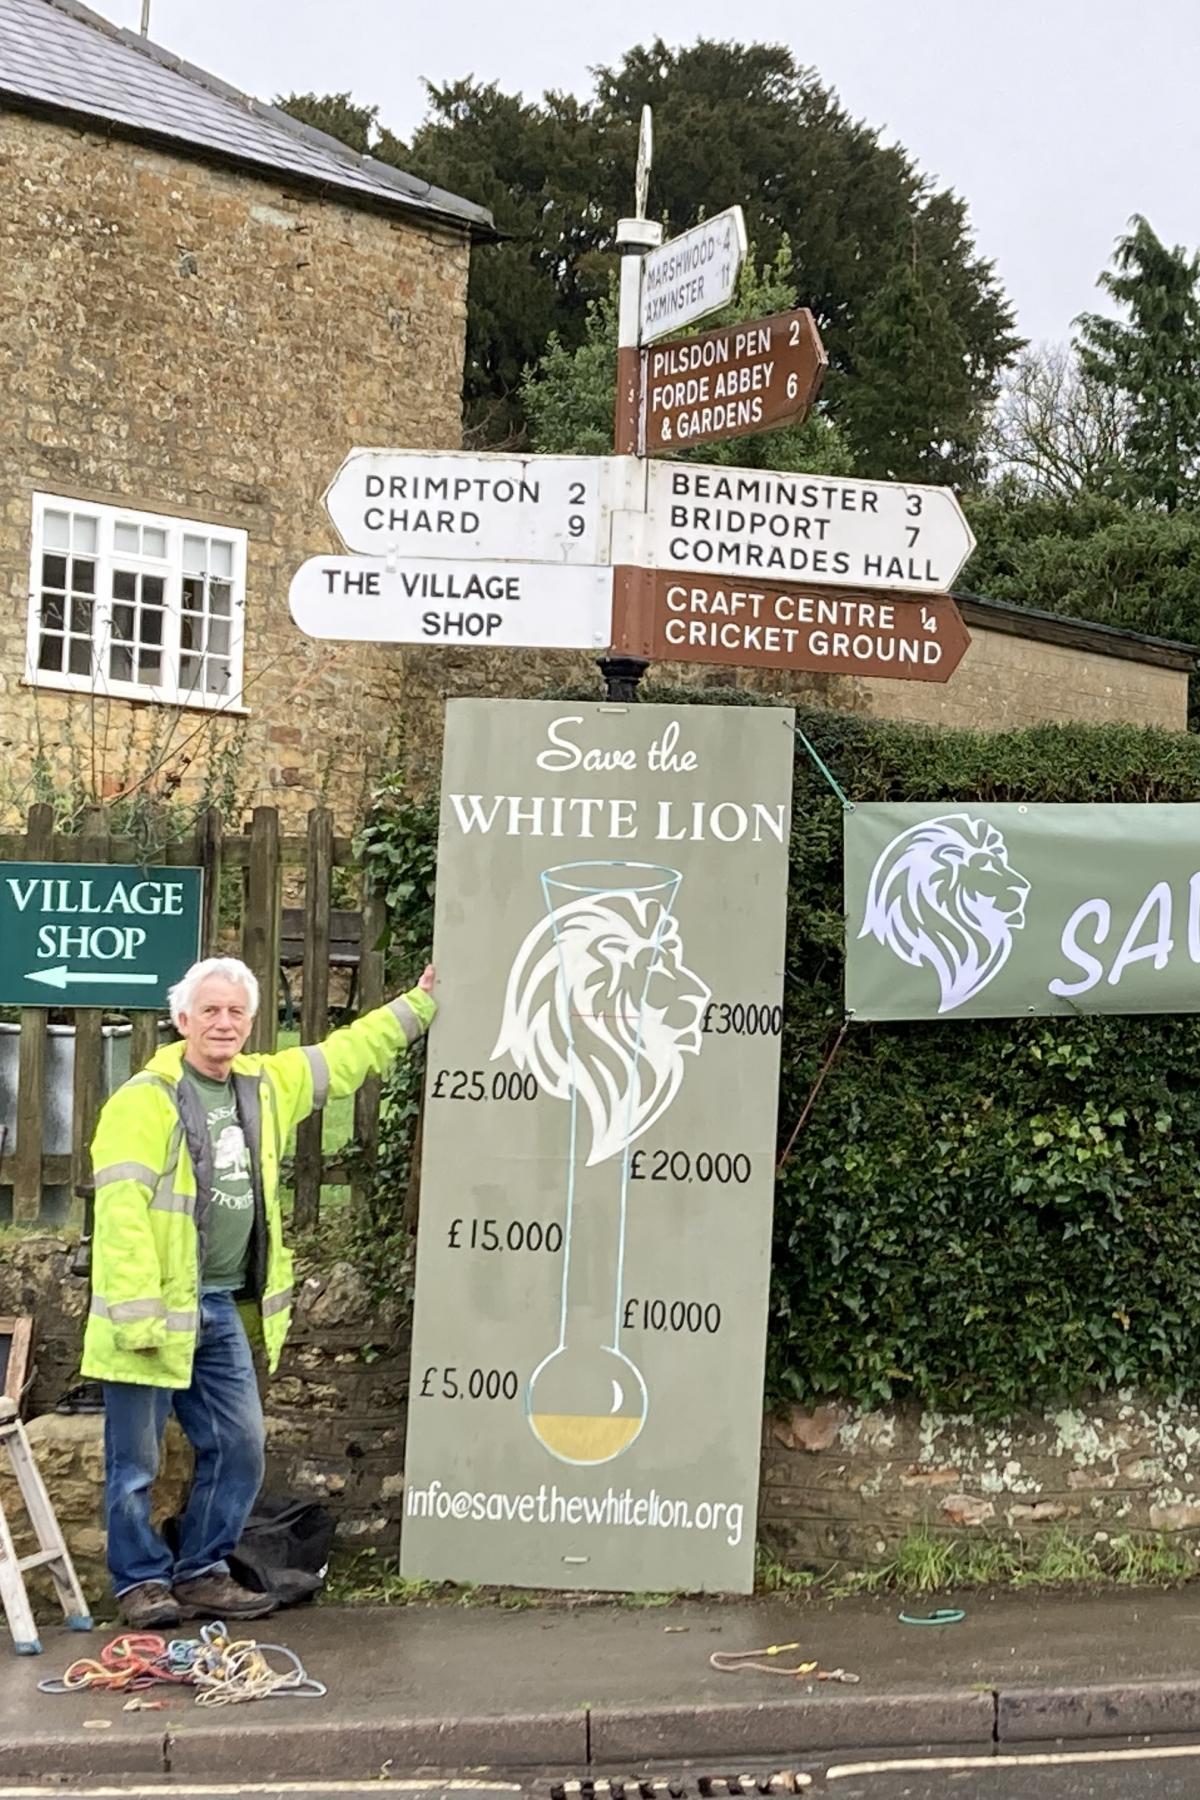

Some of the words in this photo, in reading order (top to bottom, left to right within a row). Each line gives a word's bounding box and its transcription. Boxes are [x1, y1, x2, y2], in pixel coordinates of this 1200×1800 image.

[647, 236, 715, 292] MARSHWOOD
[723, 227, 731, 250] 4
[646, 275, 705, 323] AXMINSTER
[721, 263, 730, 289] 11
[653, 340, 728, 378] PILSDON
[735, 327, 771, 357] PEN
[789, 320, 800, 347] 2
[652, 382, 709, 412] FORDE
[714, 361, 775, 398] ABBEY
[786, 374, 798, 399] 6
[660, 416, 672, 441] &
[677, 397, 763, 438] GARDENS
[365, 475, 539, 503] DRIMPTON
[568, 482, 586, 505] 2
[672, 473, 879, 514] BEAMINSTER
[905, 495, 922, 517] 3
[364, 508, 480, 534] CHARD
[568, 515, 585, 537] 9
[671, 505, 830, 540] BRIDPORT
[905, 526, 920, 548] 7
[669, 537, 850, 574] COMRADES
[864, 554, 940, 582] HALL
[322, 569, 380, 595] THE
[401, 573, 520, 601] VILLAGE
[422, 611, 503, 637] SHOP
[666, 587, 764, 618] CRAFT
[774, 596, 895, 629] CENTRE
[665, 619, 799, 653] CRICKET
[808, 630, 943, 665] GROUND
[536, 716, 637, 772] Save
[647, 720, 699, 773] the
[449, 794, 638, 839] WHITE
[655, 801, 786, 843] LION
[6, 878, 183, 916] VILLAGE
[37, 925, 147, 960] SHOP
[701, 1003, 782, 1036] £30,000
[431, 1070, 538, 1102] £25,000
[630, 1150, 751, 1184] £20,000
[448, 1218, 563, 1253] £15,000
[623, 1299, 721, 1333] £10,000
[419, 1367, 518, 1400] £5,000
[406, 1480, 744, 1546] info@savethewhitelion.org
